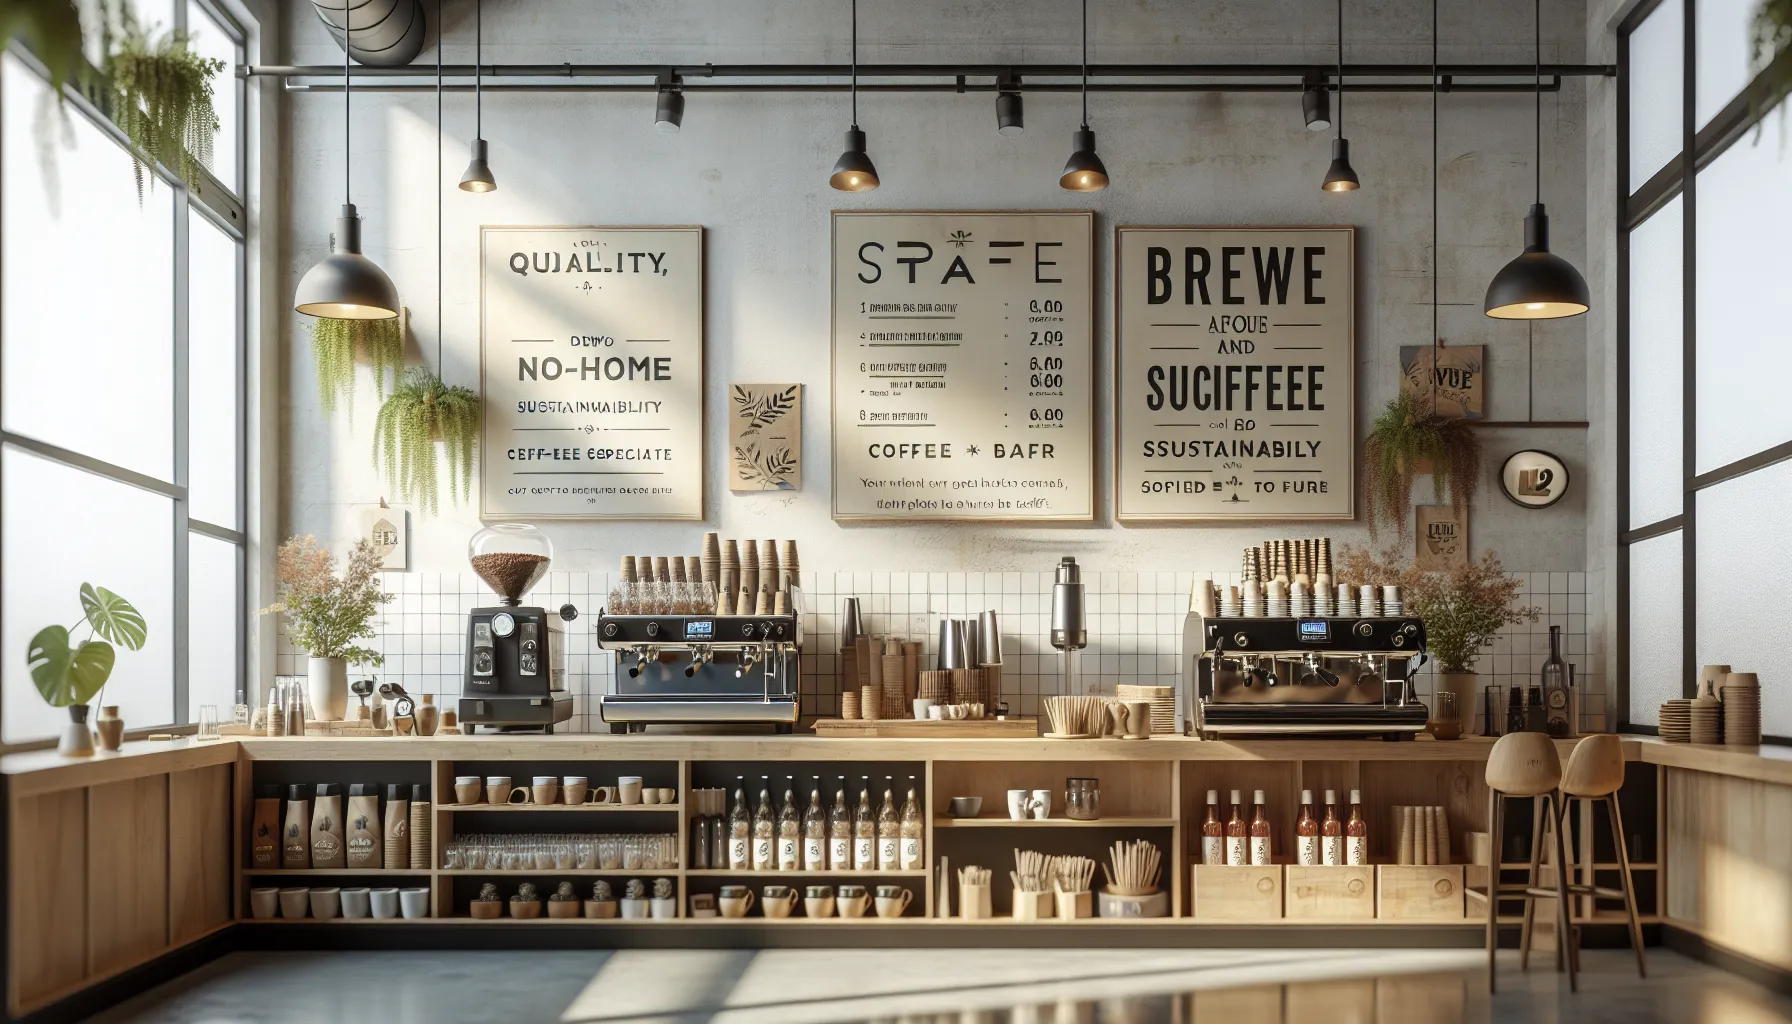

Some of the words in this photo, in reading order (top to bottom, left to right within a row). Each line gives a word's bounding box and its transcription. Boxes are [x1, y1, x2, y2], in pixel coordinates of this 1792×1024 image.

[1148, 247, 1325, 305] BREWE
[1218, 340, 1254, 354] AND
[519, 356, 671, 381] NO-HOME
[869, 444, 951, 459] COFFEE
[994, 444, 1054, 459] BAFR
[1255, 482, 1274, 493] TO
